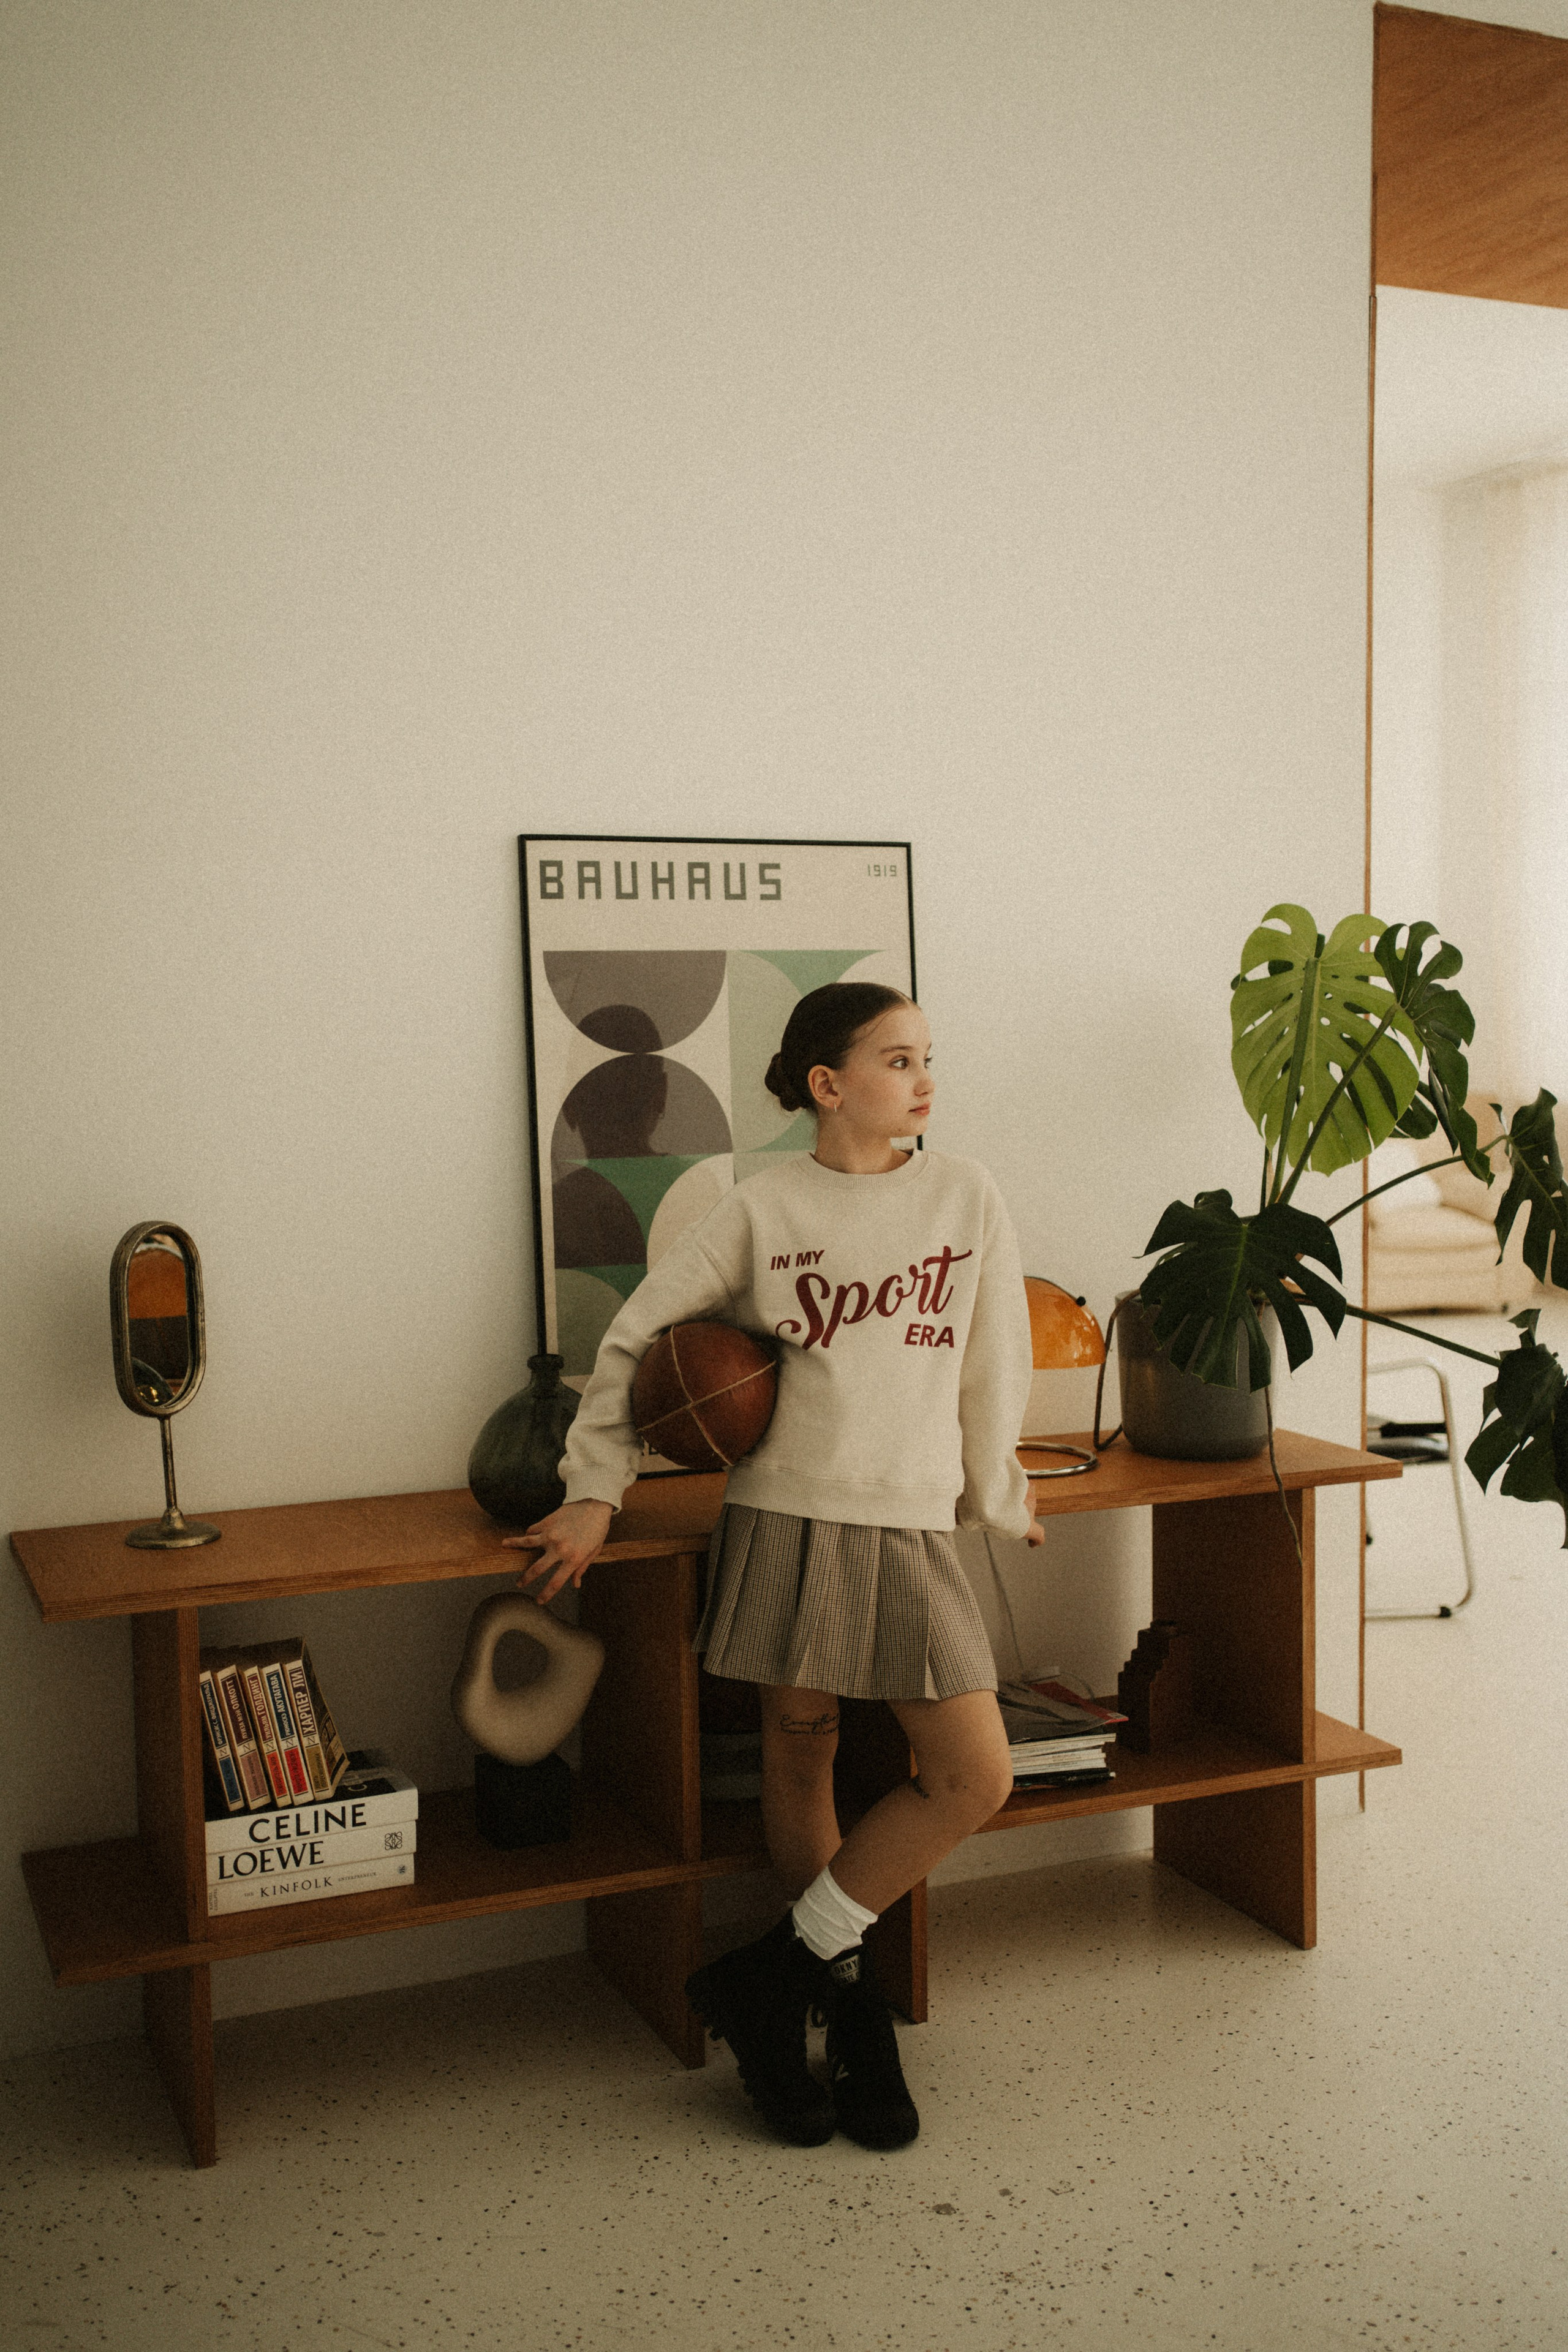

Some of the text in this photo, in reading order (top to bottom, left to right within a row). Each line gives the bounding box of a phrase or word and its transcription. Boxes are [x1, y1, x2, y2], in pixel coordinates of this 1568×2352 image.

[539, 859, 782, 900] BAUHAUS
[867, 864, 897, 877] 1919
[770, 1250, 826, 1270] IN MY
[775, 1245, 973, 1351] Sport
[904, 1322, 955, 1348] ERA
[225, 1678, 240, 1709] ОЛКОТТ
[270, 1674, 285, 1713] АКУТАГАВА
[291, 1670, 303, 1689] ЛИ
[203, 1683, 217, 1720] ФИЦДЖЕРАЛЬД
[249, 1677, 272, 1738] УИЛЬЯМ ГОЛДИНГ
[295, 1691, 315, 1734] ХАРПЕР
[238, 1721, 248, 1740] ЛУИЗА
[249, 1803, 367, 1843] CELINE
[218, 1841, 325, 1880] LOEWE
[261, 1876, 333, 1898] KINFOLK
